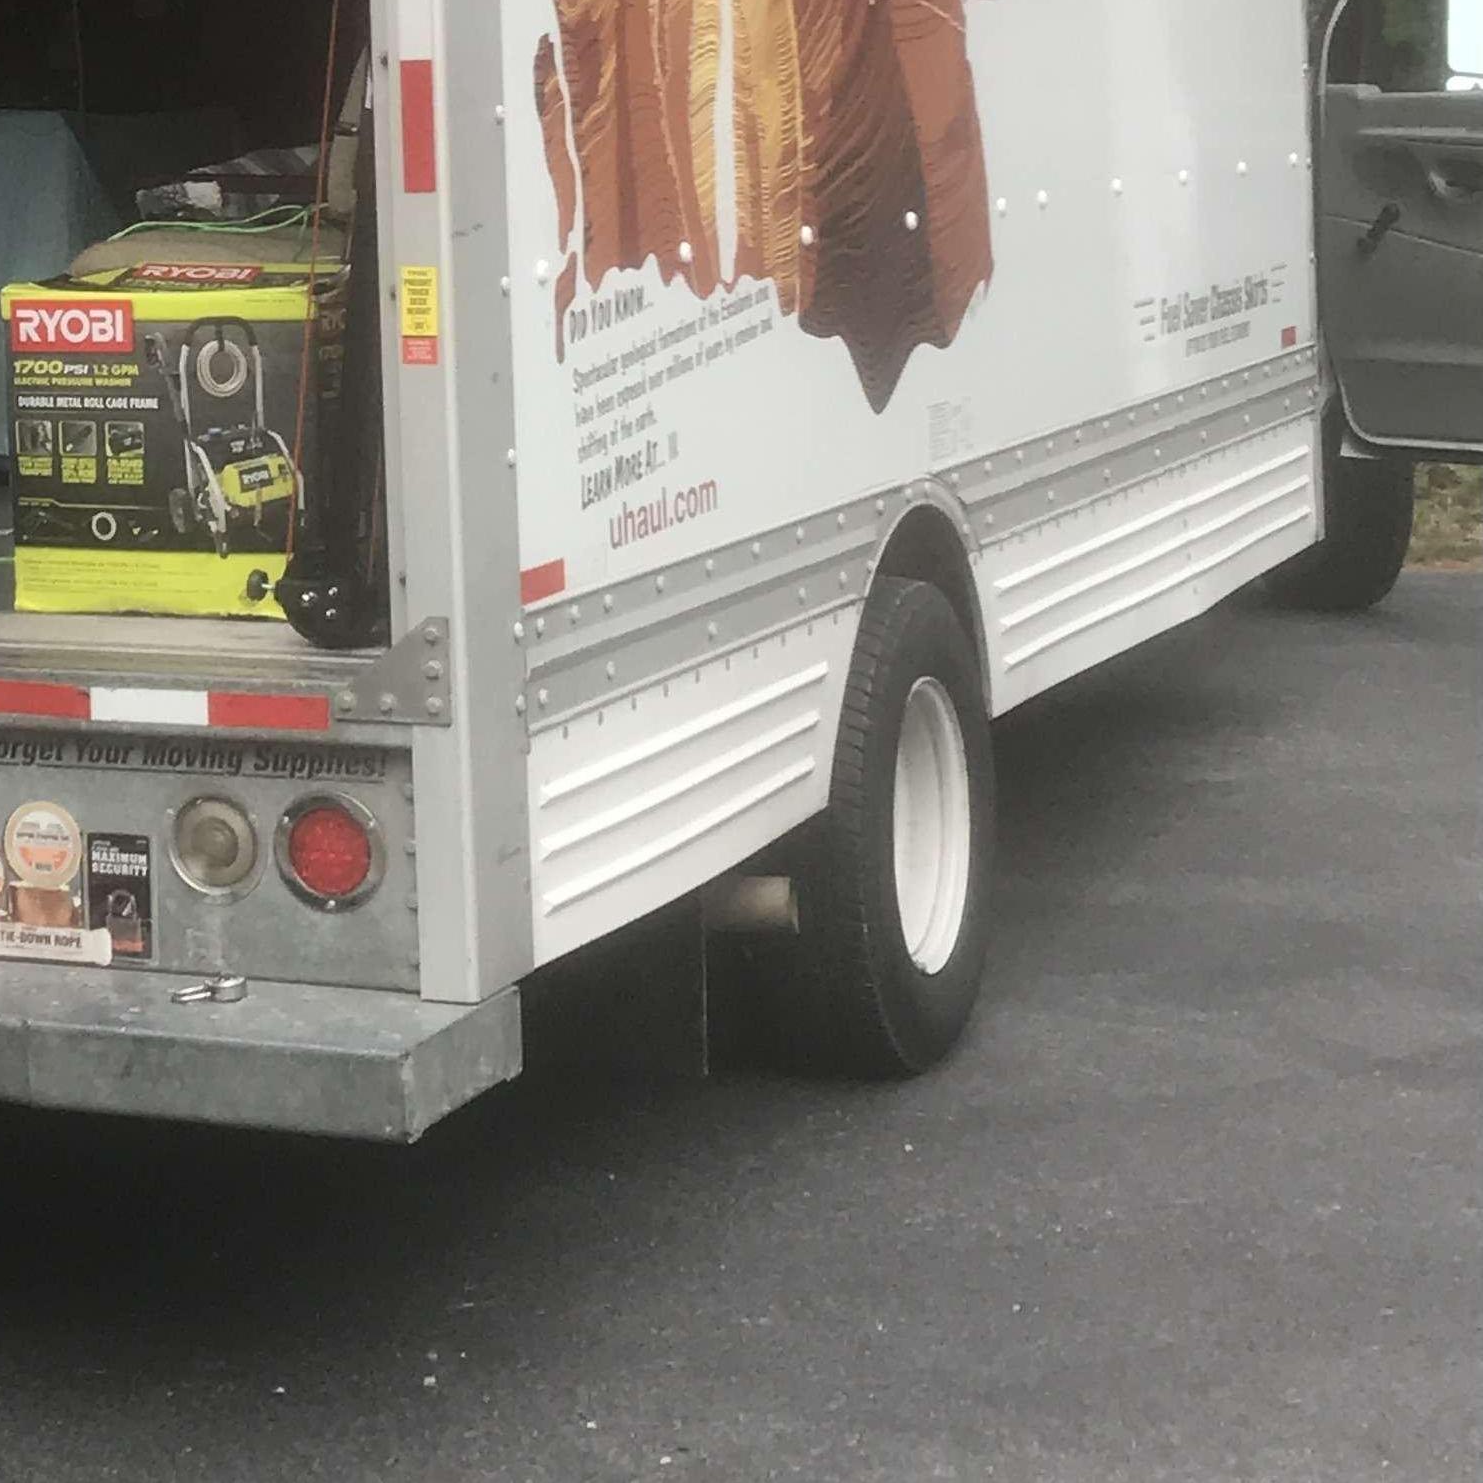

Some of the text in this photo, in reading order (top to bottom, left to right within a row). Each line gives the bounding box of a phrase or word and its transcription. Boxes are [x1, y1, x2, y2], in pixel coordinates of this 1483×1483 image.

[142, 266, 252, 280] RYOBI
[590, 299, 611, 334] YOU
[16, 309, 124, 344] RYOBI
[13, 360, 63, 374] 1700
[64, 364, 89, 375] PSI
[18, 396, 159, 409] DURABLE METAL ROLL CAGE FRAME
[581, 465, 612, 510] LEARN
[615, 450, 643, 491] MORE
[610, 478, 718, 550] uhaul.com
[77, 737, 133, 765] Your
[142, 742, 244, 776] Moving
[92, 851, 148, 865] MAXIMUM
[92, 863, 148, 877] SECURITY
[0, 930, 83, 949] TIE-DOWN ROPE
